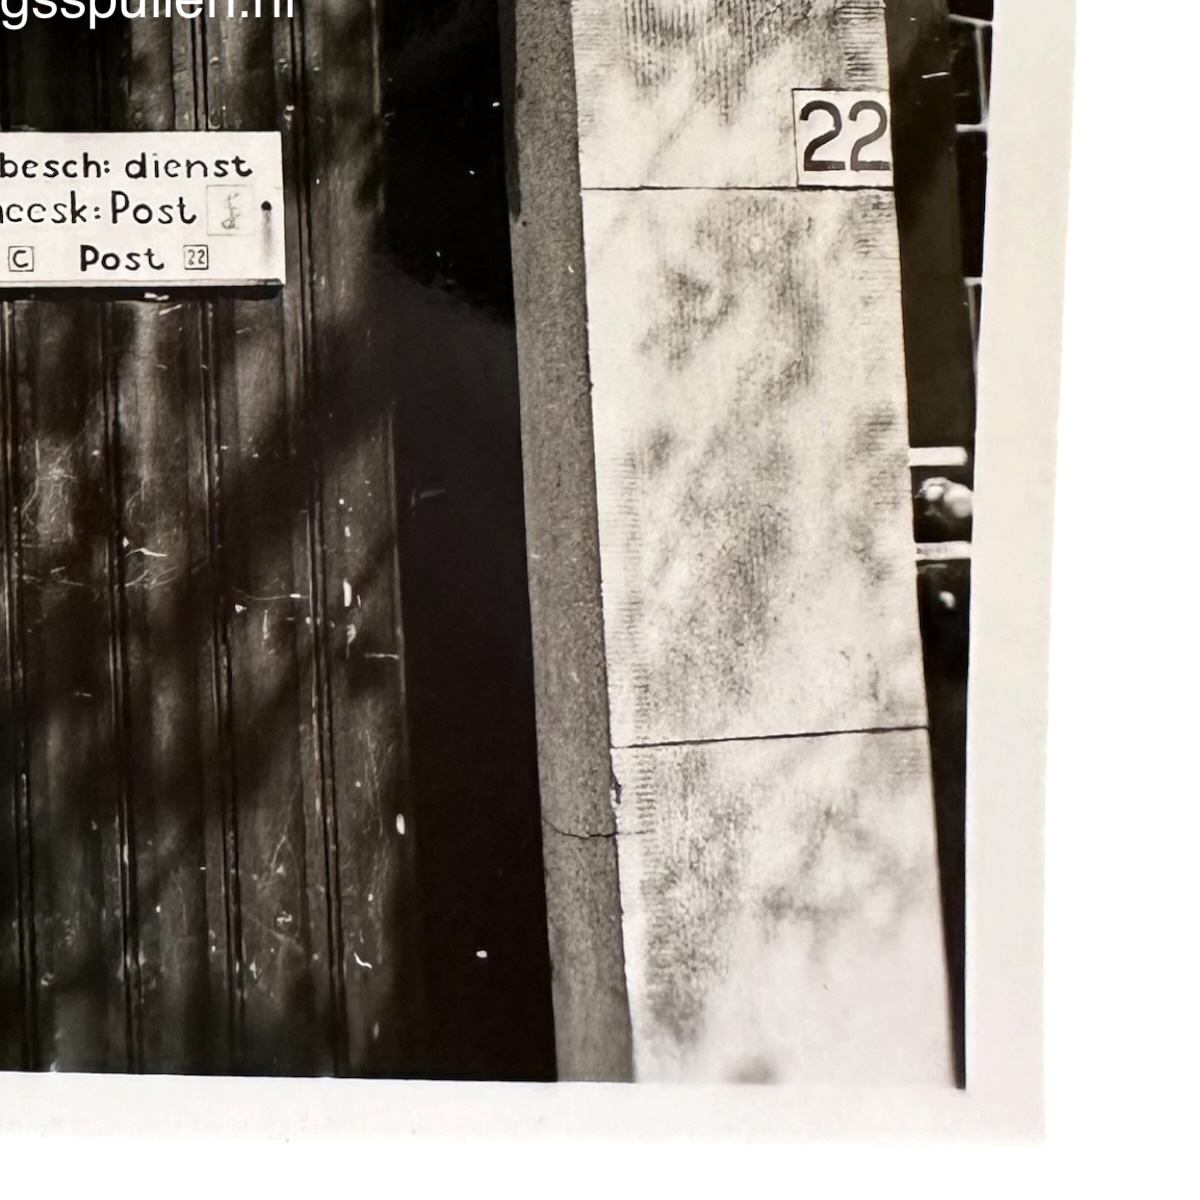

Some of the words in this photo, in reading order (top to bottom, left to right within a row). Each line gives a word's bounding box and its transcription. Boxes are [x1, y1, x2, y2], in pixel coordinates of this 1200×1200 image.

[800, 100, 891, 172] 22
[124, 152, 253, 180] dienst
[111, 190, 197, 225] Post
[12, 249, 29, 268] C
[80, 244, 165, 272] Post
